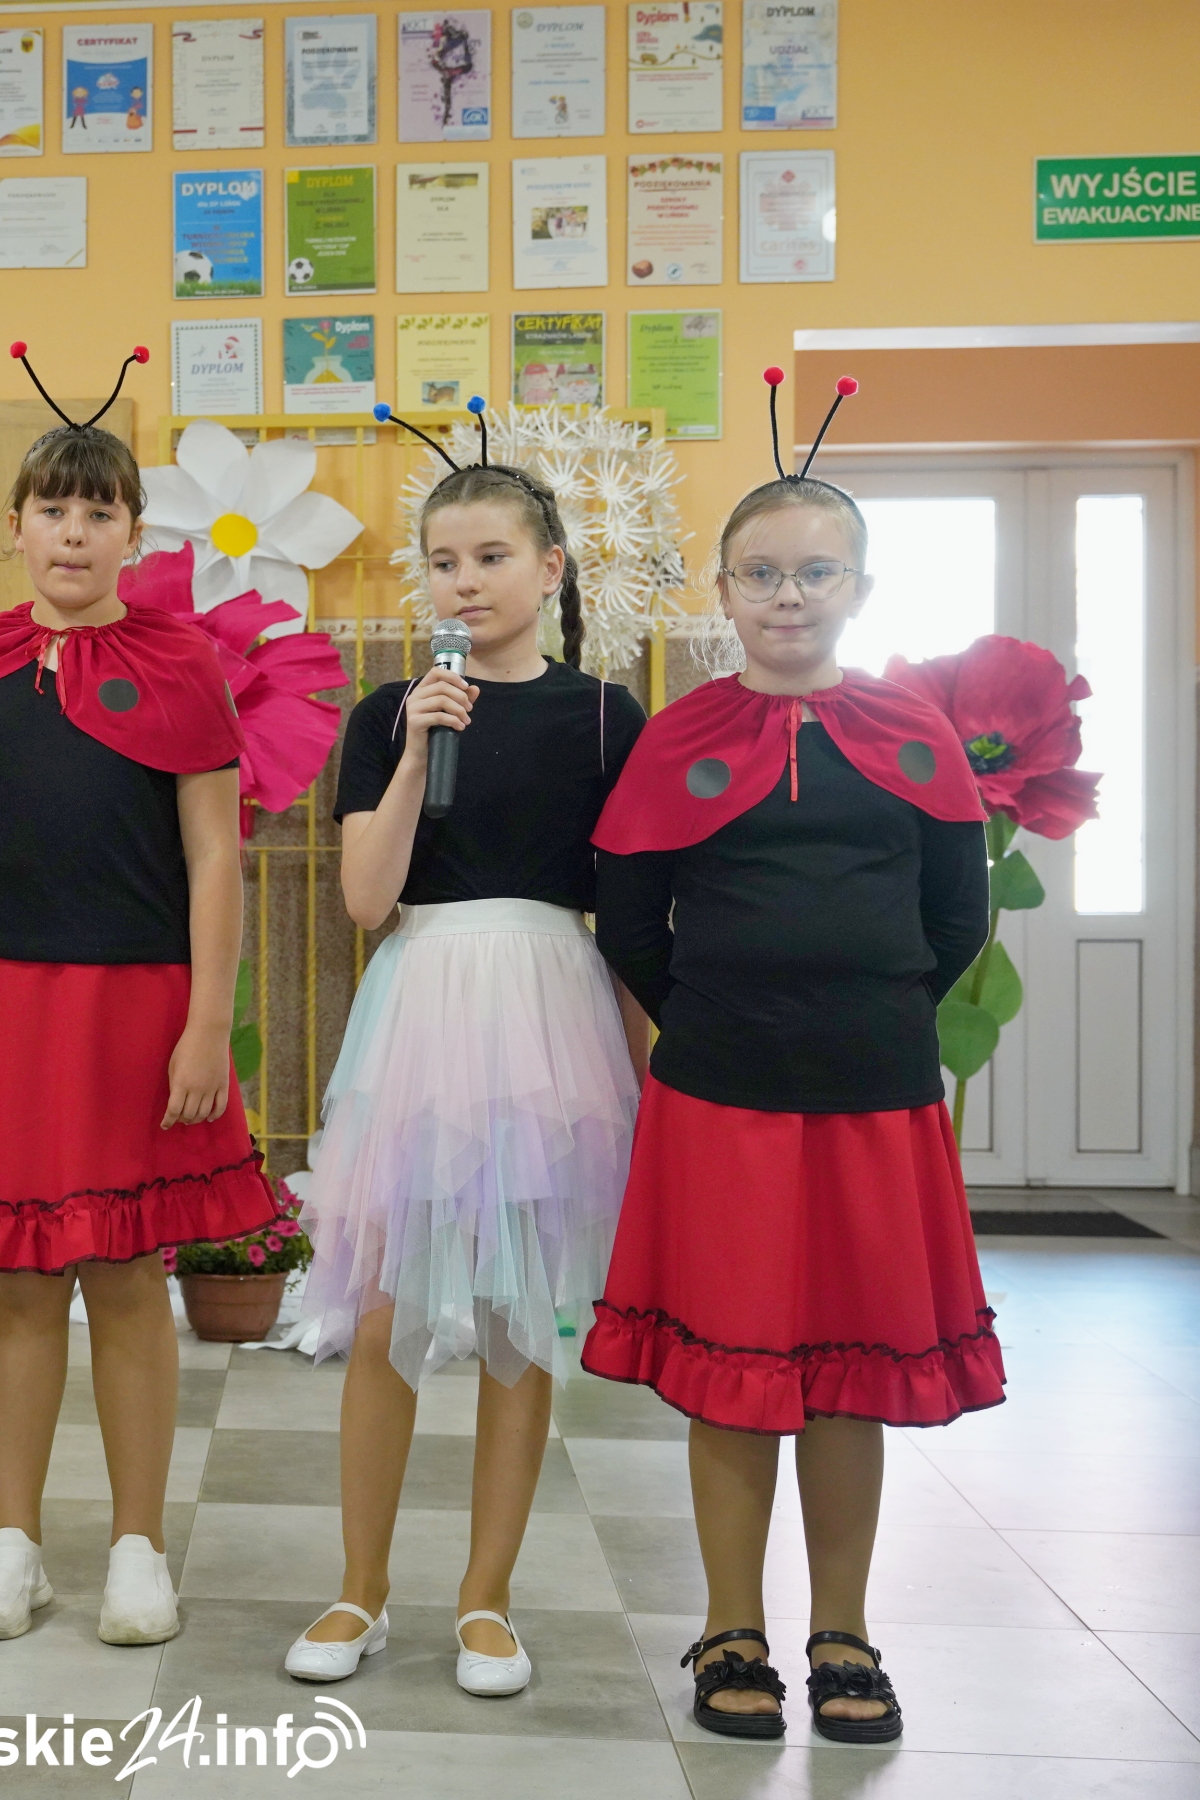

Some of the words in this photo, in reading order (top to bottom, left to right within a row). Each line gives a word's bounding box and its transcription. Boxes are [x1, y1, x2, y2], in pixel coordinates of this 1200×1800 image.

[636, 10, 679, 25] Dyplom
[766, 6, 816, 17] DYPLOM
[536, 22, 585, 32] DYPLOM
[77, 37, 138, 46] CERTYFIKAT
[306, 175, 354, 188] DYPLOM
[1051, 166, 1197, 199] WYJŚCIE
[181, 181, 256, 197] DYPLOM
[1042, 204, 1200, 225] EWAKUACYJNE
[335, 321, 370, 333] Dyplom
[515, 316, 602, 330] CERTYFIKAT
[191, 363, 244, 375] DYPLOM
